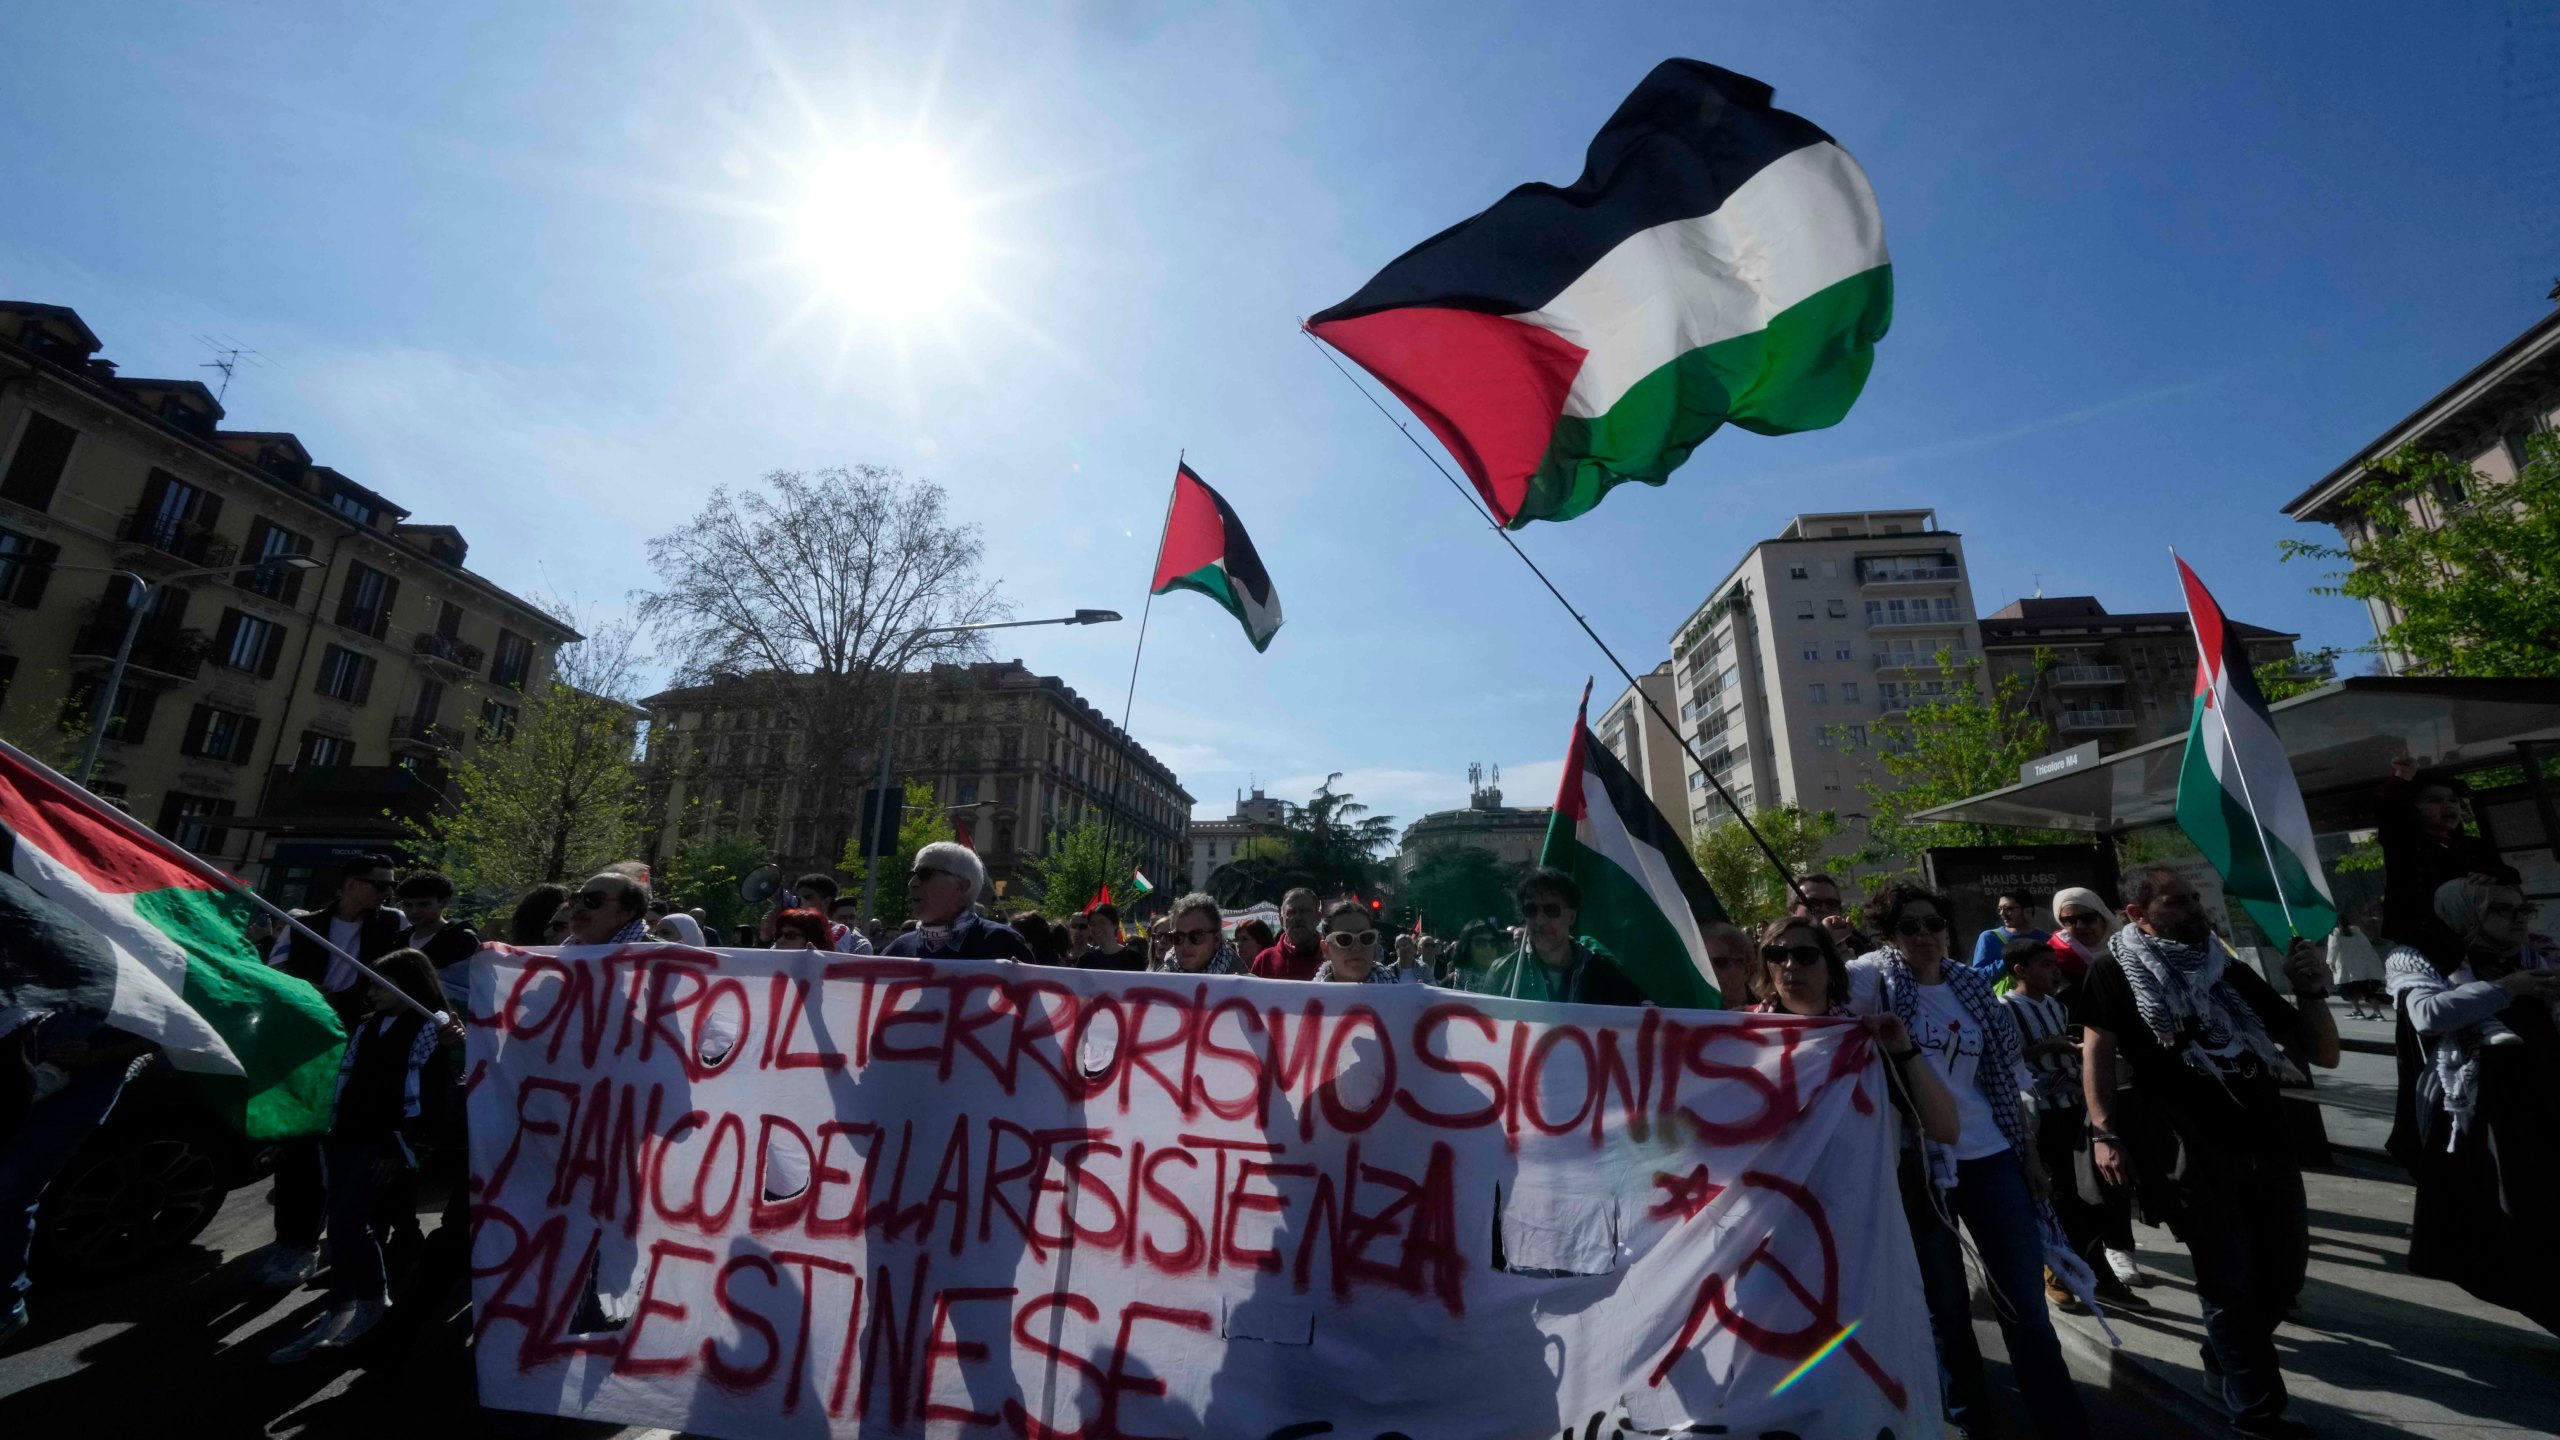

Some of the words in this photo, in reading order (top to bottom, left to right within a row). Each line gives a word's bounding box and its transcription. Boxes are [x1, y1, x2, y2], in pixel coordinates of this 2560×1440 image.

[2034, 759, 2065, 776] Tricolore
[2066, 753, 2078, 767] M4
[1981, 874, 2019, 885] HAUS
[2021, 873, 2058, 885] LABS
[1984, 887, 1998, 896] BY
[760, 971, 848, 1070] IL
[824, 961, 1397, 1142] TERRORISMO
[483, 1076, 746, 1239] FIANCO
[749, 1113, 968, 1256] DELLA
[978, 1117, 1467, 1318] RESISTENZA
